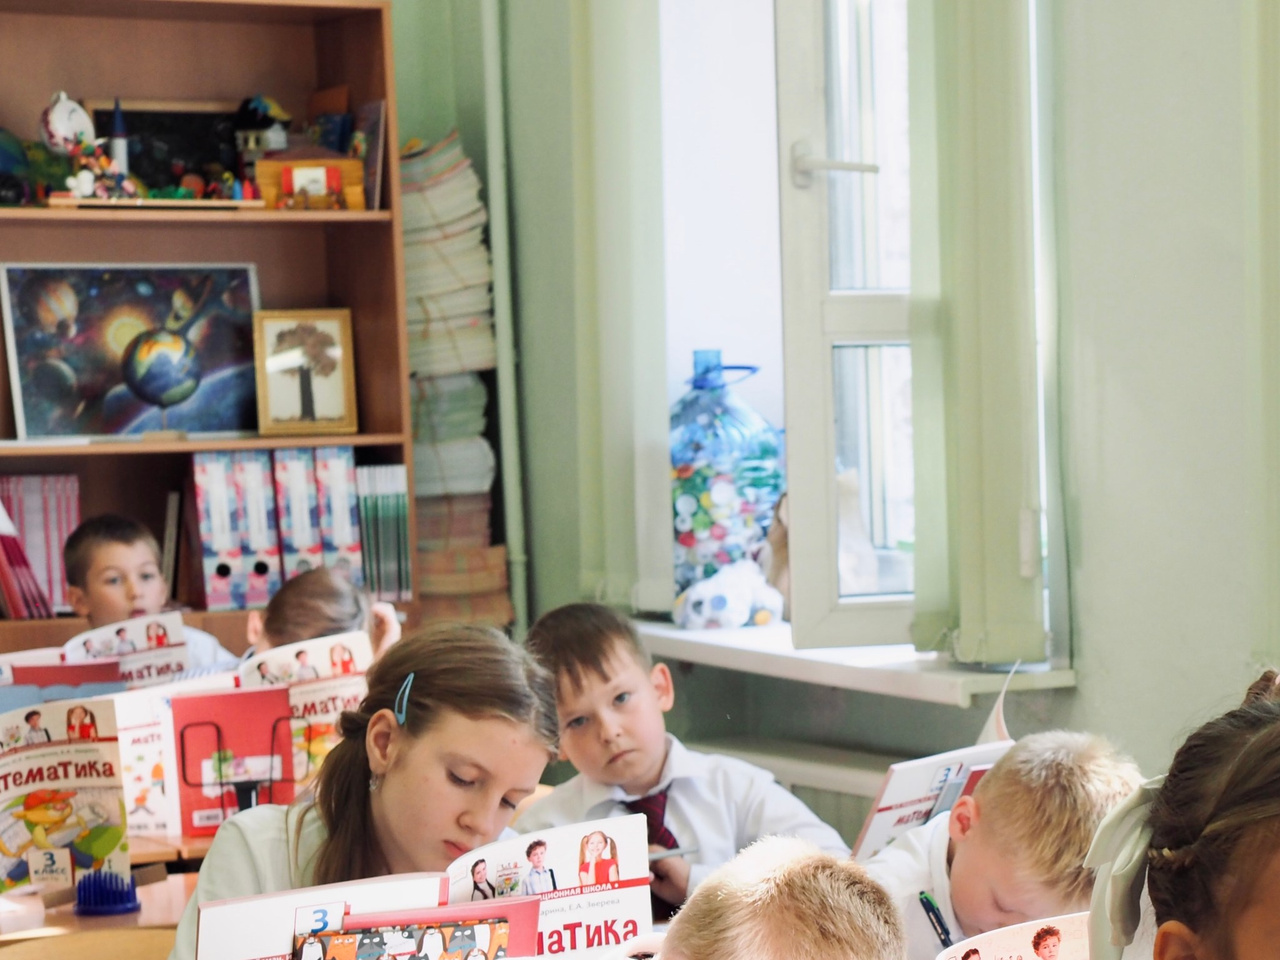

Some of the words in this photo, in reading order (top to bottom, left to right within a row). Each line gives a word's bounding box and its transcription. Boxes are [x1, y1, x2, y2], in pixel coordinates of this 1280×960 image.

[0, 760, 115, 791] тематика
[582, 883, 612, 894] ШКОЛА
[311, 908, 329, 934] 3
